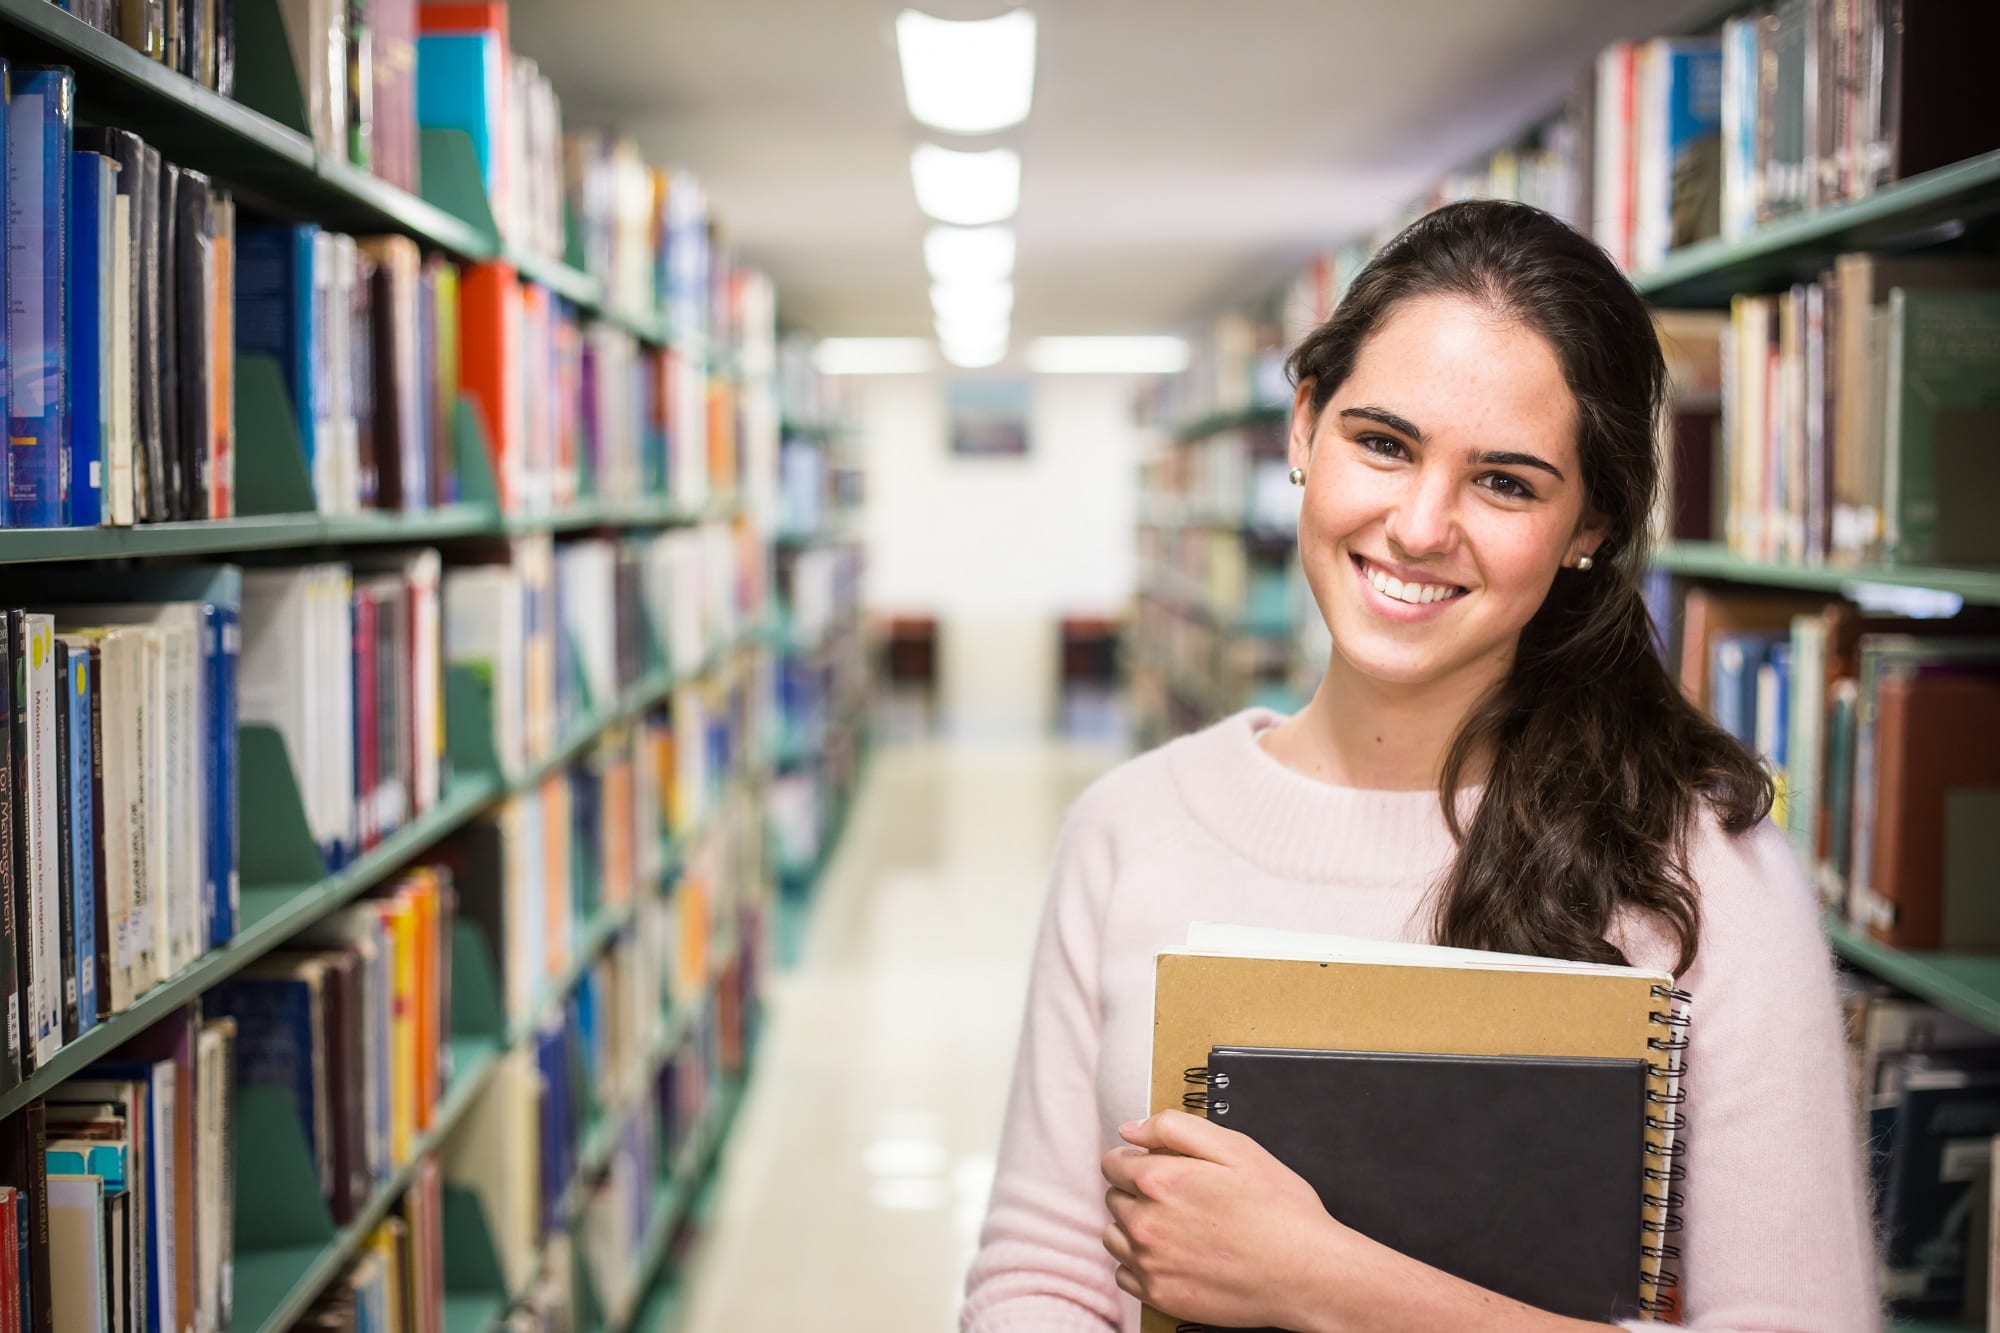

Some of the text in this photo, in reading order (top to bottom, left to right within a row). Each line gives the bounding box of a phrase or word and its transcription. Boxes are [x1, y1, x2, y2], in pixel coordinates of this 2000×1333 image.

[59, 714, 67, 806] Introduction
[62, 809, 68, 826] to
[0, 802, 11, 937] Management
